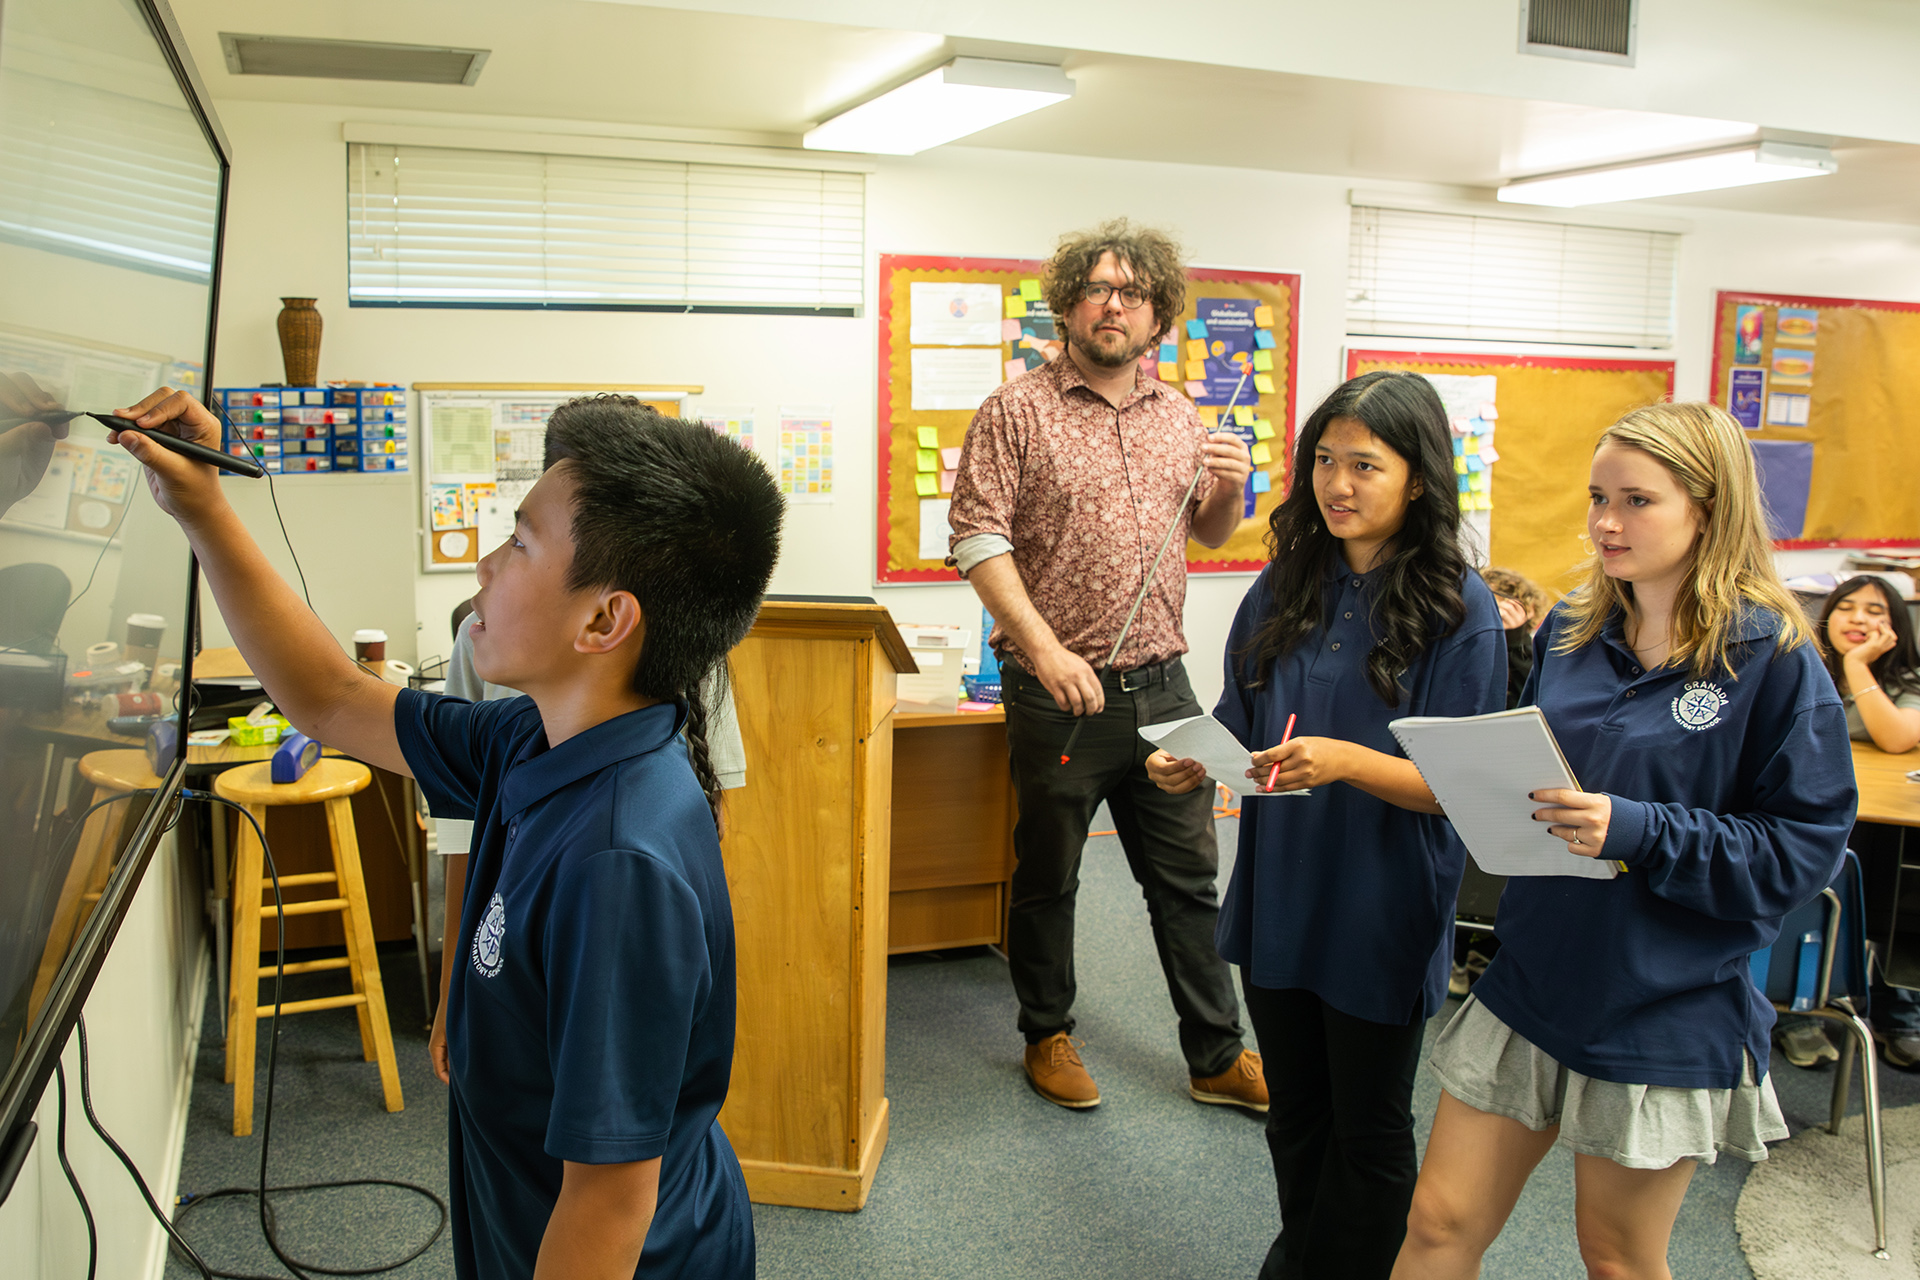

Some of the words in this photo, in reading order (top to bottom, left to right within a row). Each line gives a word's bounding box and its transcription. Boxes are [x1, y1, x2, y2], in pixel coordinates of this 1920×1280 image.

[1684, 681, 1730, 706] GRANADA
[1671, 697, 1697, 731] PREPARATORY
[1696, 716, 1722, 731] SCHOOL
